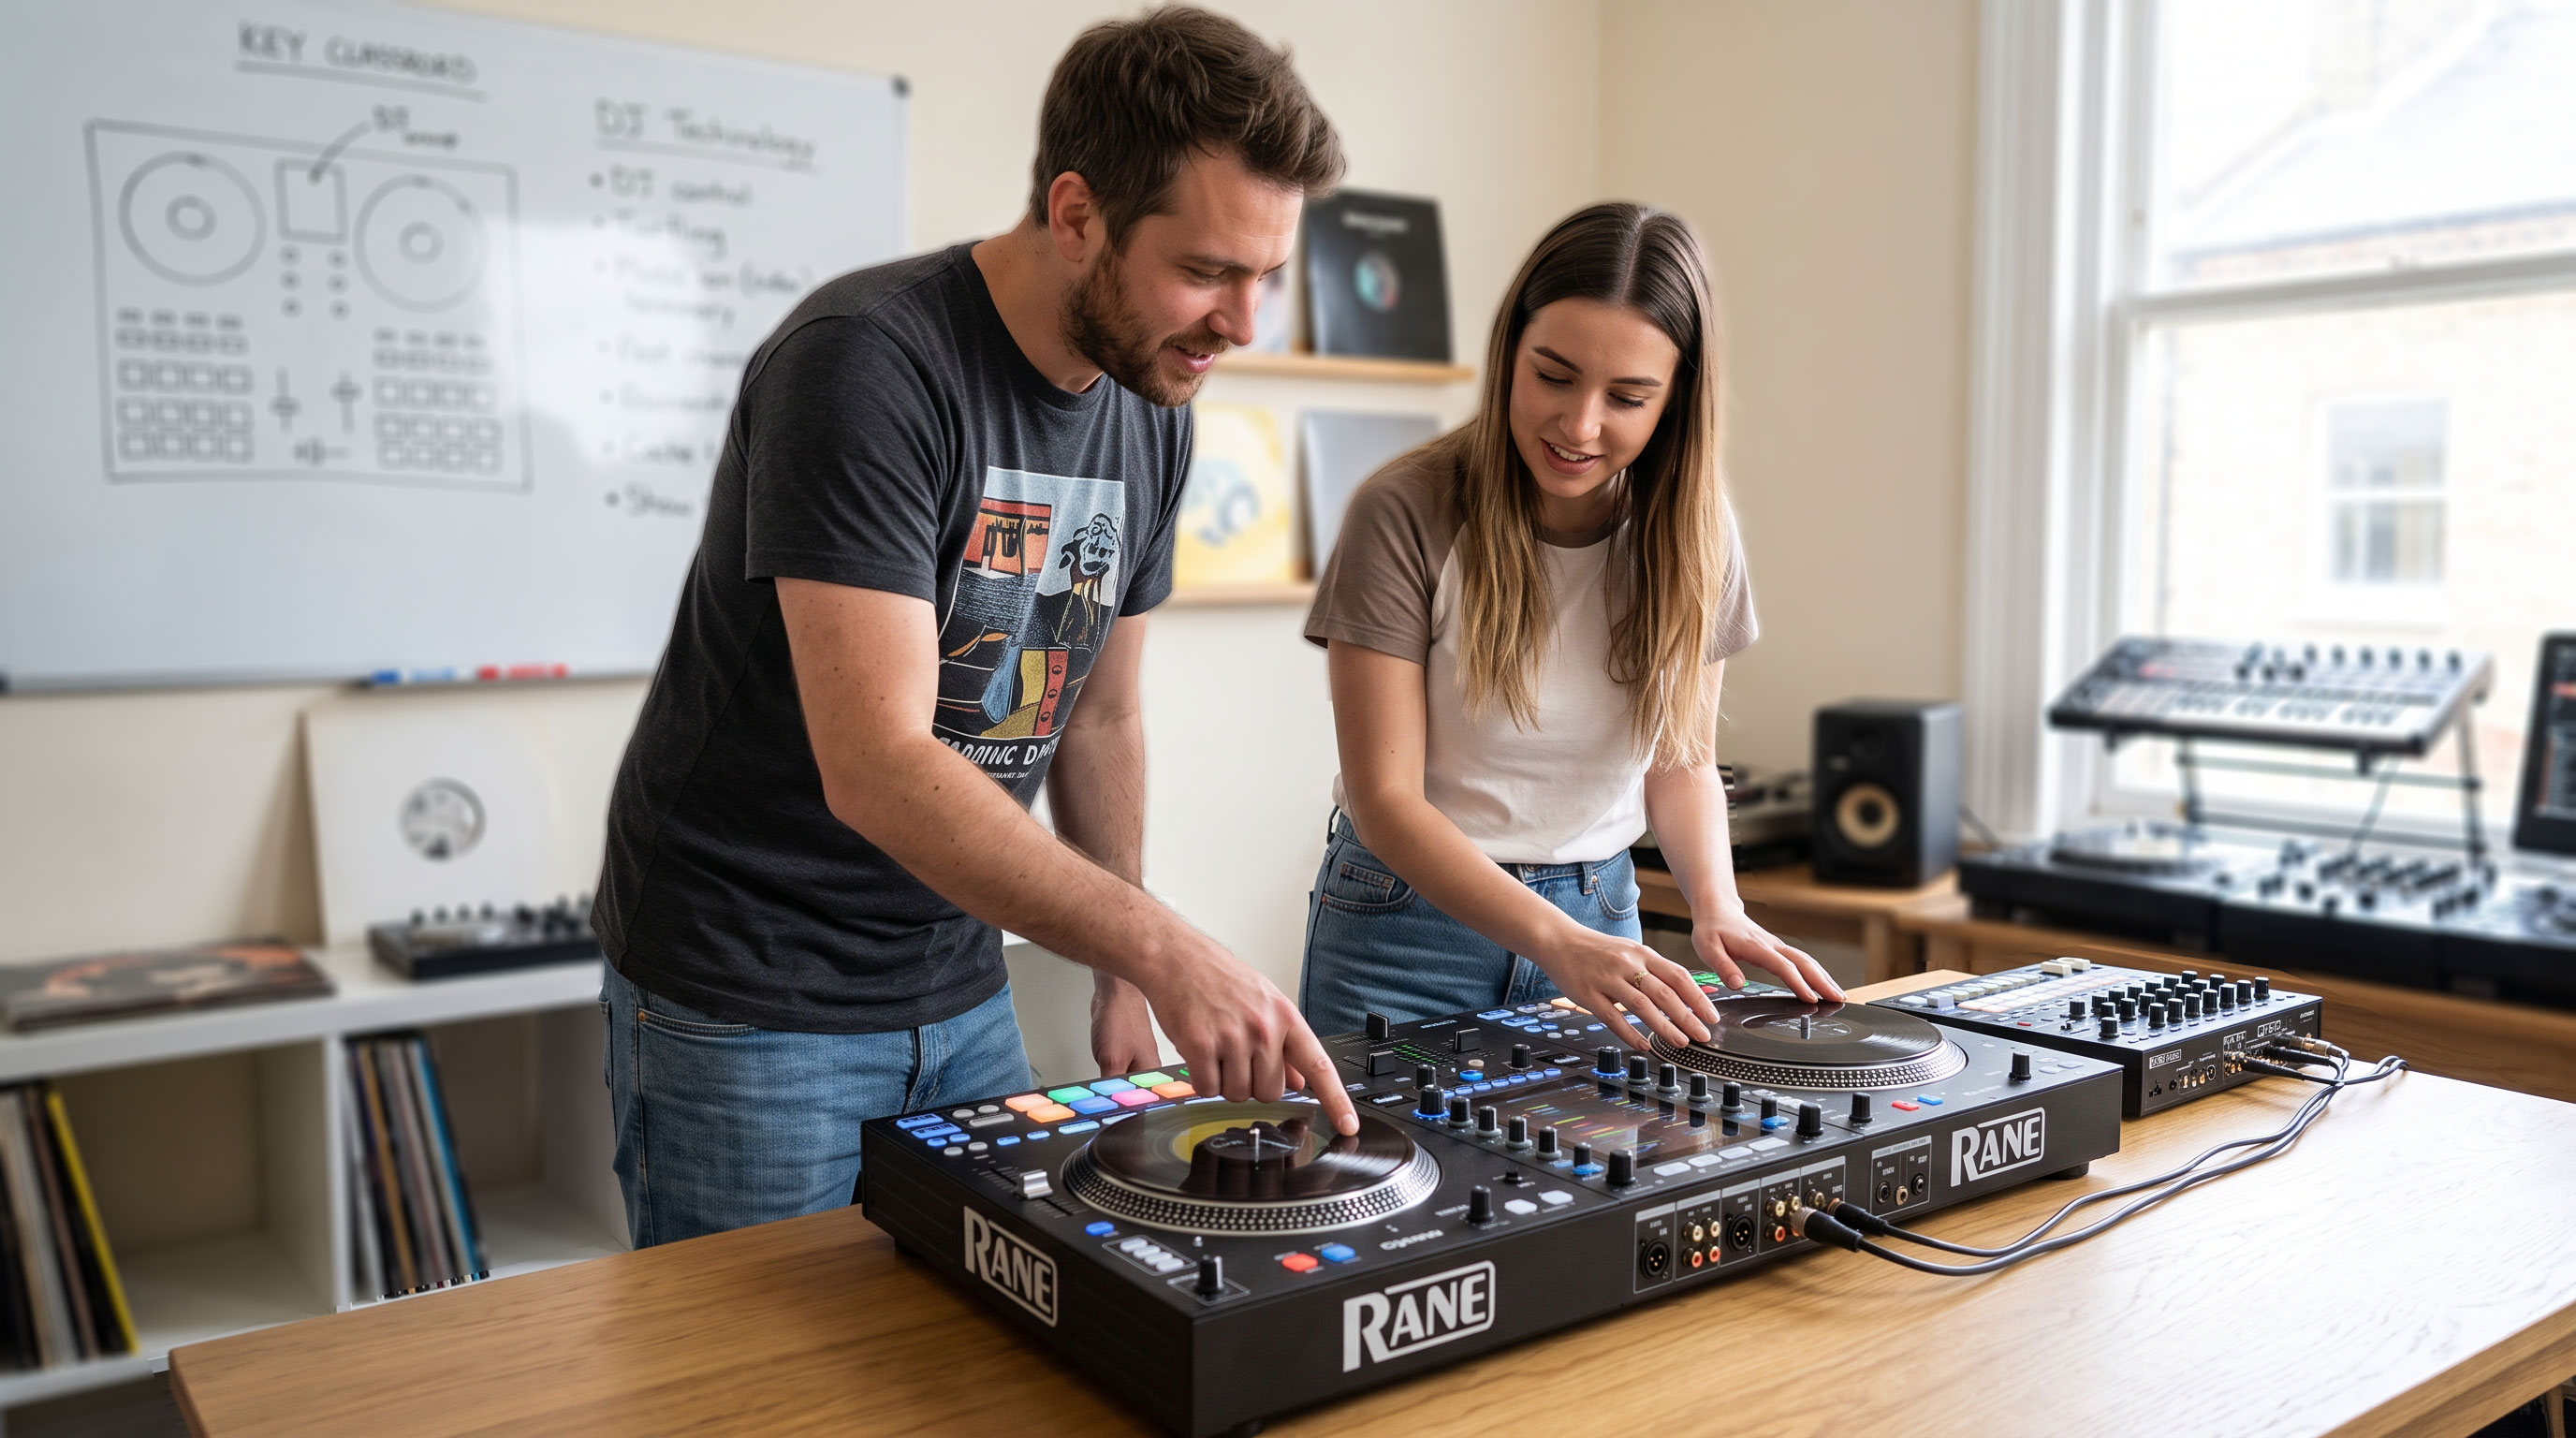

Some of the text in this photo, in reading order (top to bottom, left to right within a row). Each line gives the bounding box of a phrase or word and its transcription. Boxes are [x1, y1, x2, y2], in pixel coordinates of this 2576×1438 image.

[1951, 1115, 2041, 1187] RANE
[964, 1205, 1052, 1314] RANE
[1343, 1271, 1486, 1372] RANE
